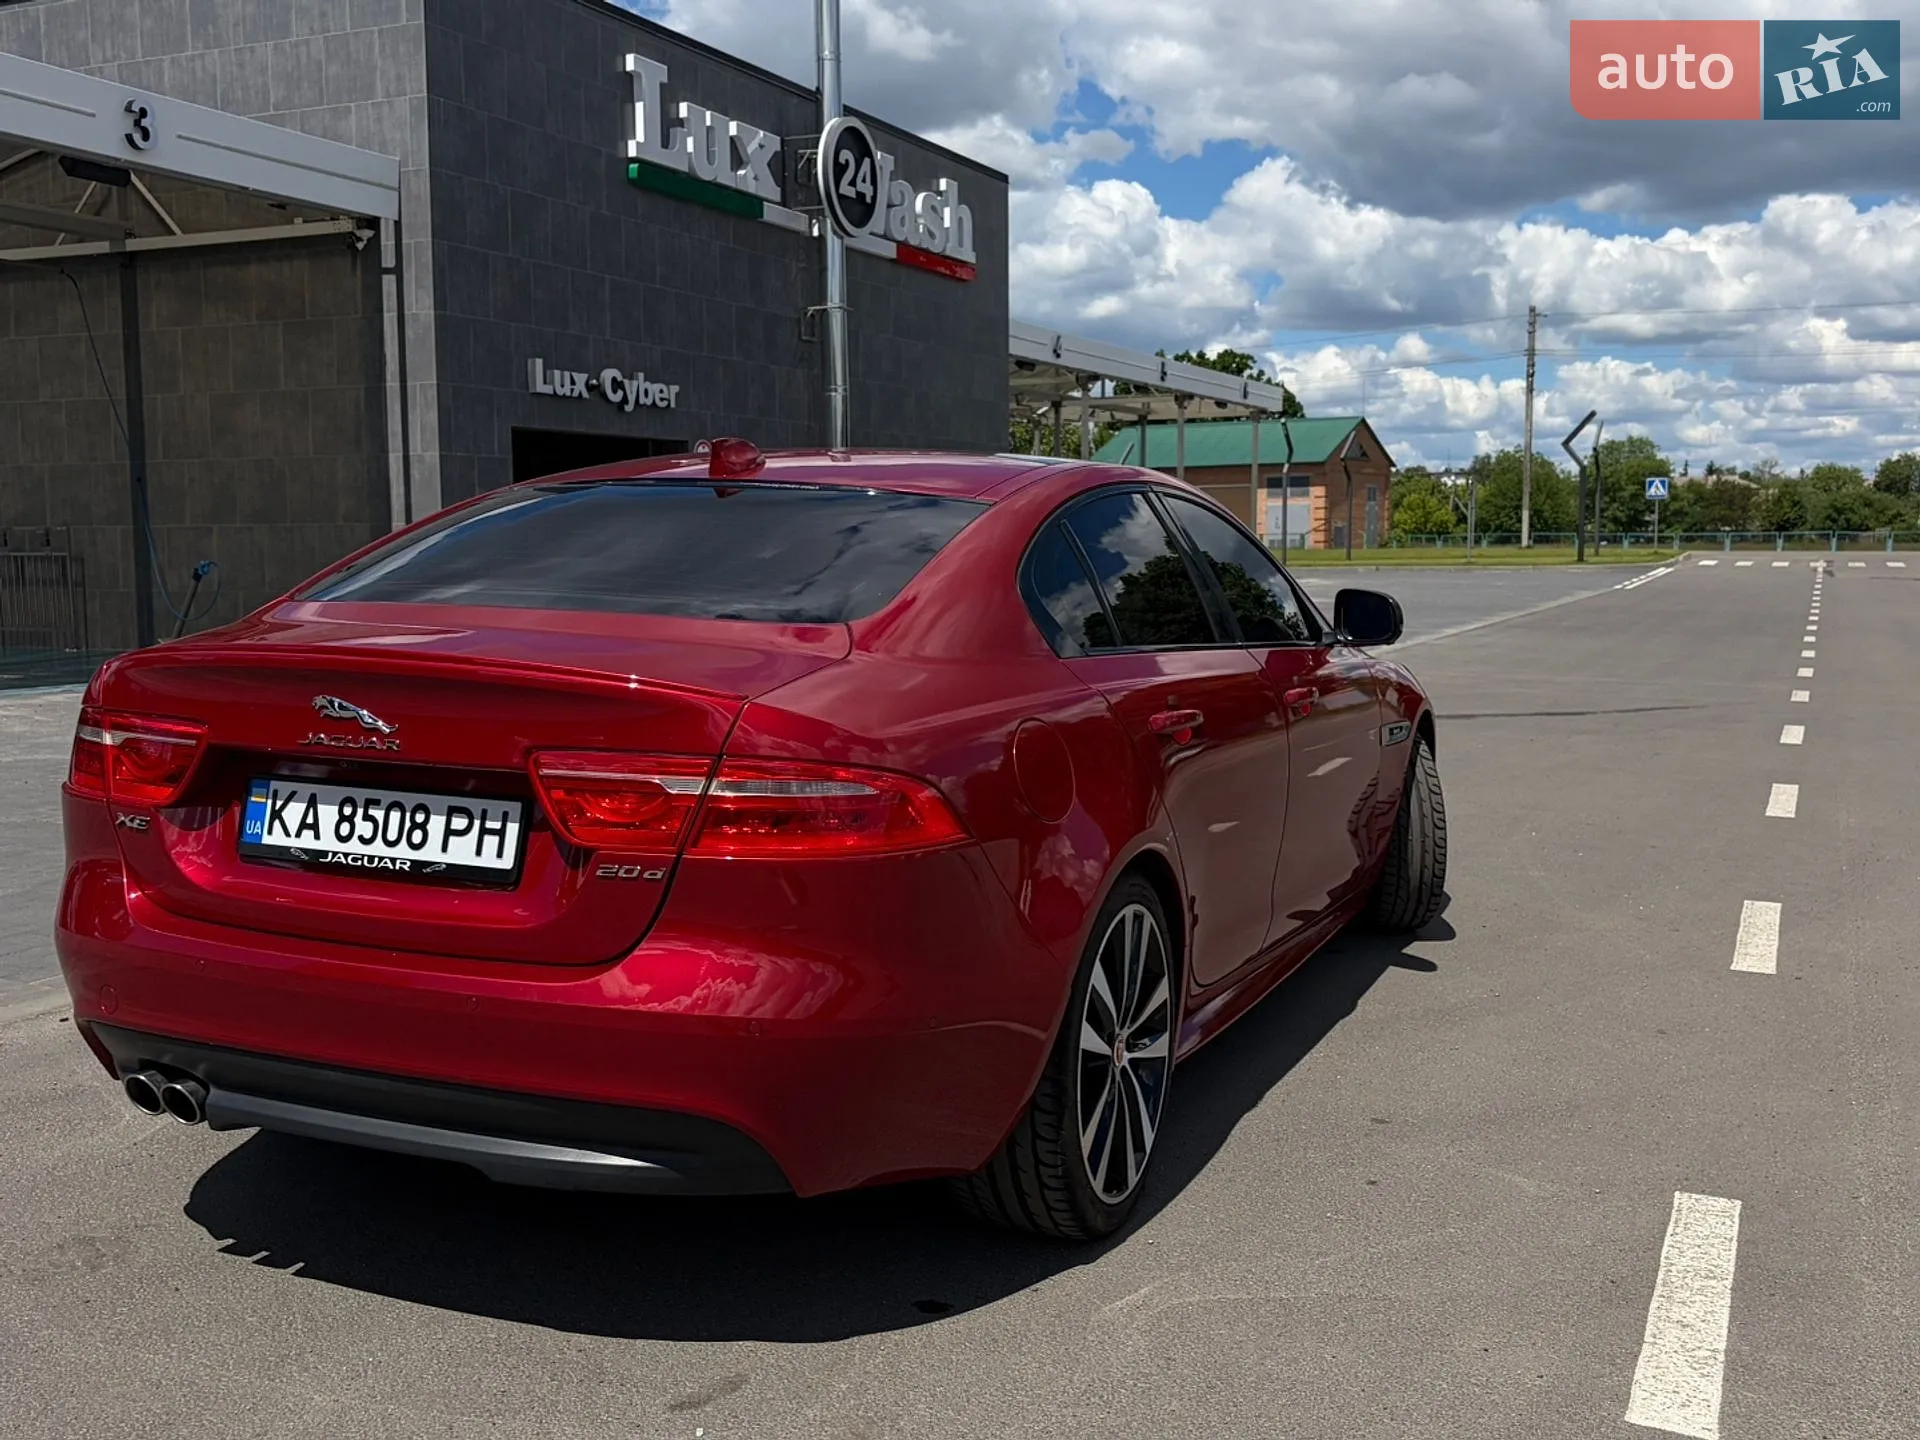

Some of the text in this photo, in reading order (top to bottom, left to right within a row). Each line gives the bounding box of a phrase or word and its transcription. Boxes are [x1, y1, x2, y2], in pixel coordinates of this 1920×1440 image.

[124, 98, 158, 151] 3
[625, 53, 781, 202] Lux
[838, 150, 873, 204] 24
[297, 732, 401, 750] JAGUAR
[115, 812, 150, 830] XE
[246, 819, 262, 835] UA
[267, 789, 509, 859] KA 8508 PH
[319, 851, 411, 871] JAGUAR
